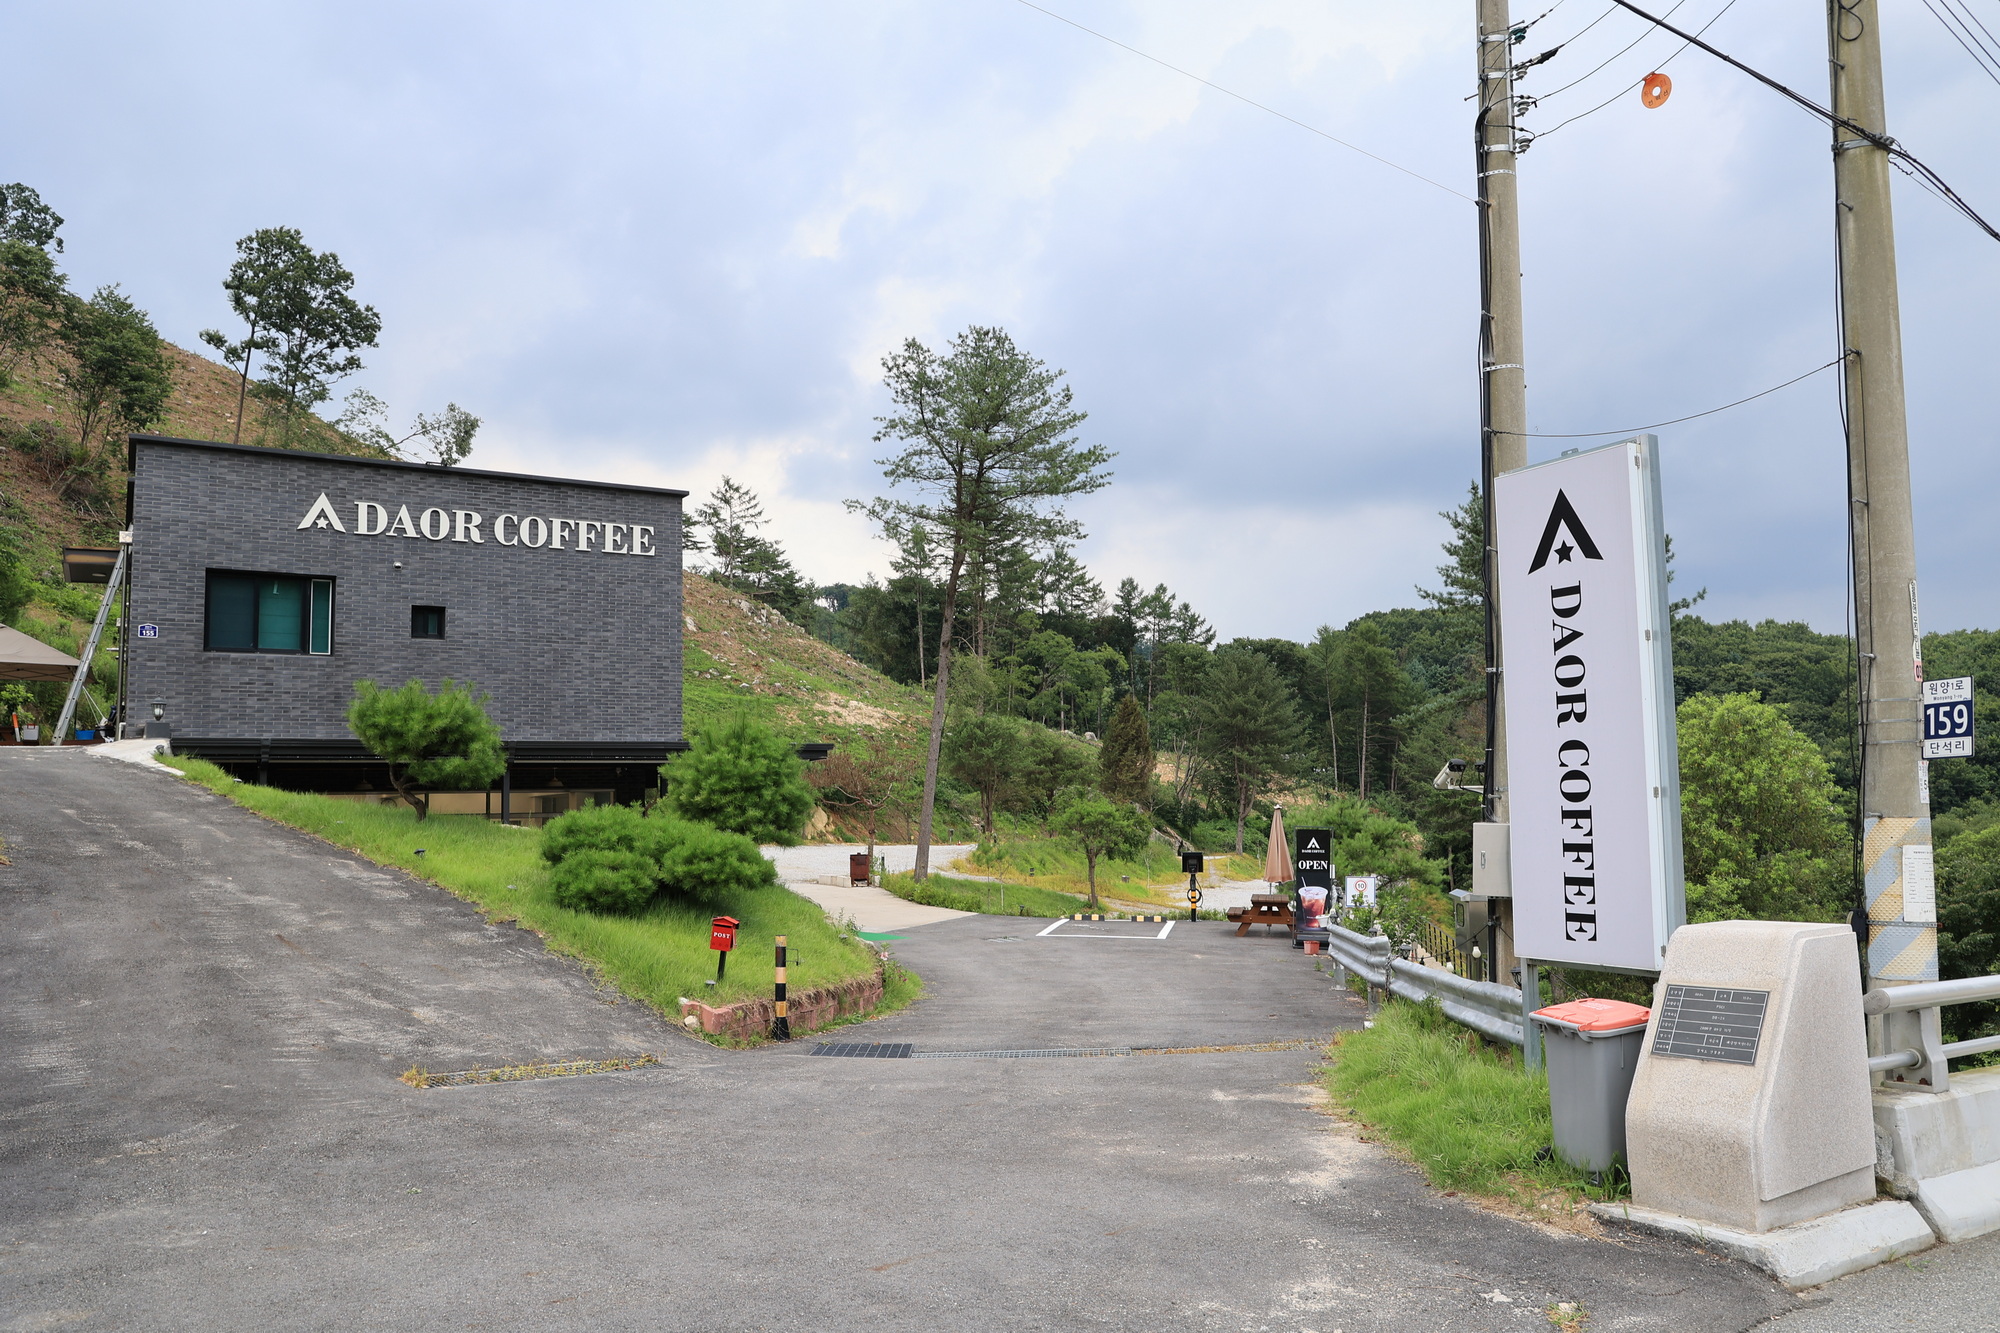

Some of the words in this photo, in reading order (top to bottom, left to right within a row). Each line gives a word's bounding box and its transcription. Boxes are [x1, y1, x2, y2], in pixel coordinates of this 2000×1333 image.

[353, 501, 485, 544] DAOR
[494, 513, 656, 556] COFFEE
[1550, 579, 1588, 729] DAOR
[1929, 680, 1964, 695] 원양1로
[1926, 704, 1968, 736] 159
[1930, 740, 1965, 754] 단석리
[1557, 739, 1598, 943] COFFEE
[1298, 860, 1328, 870] OPEN
